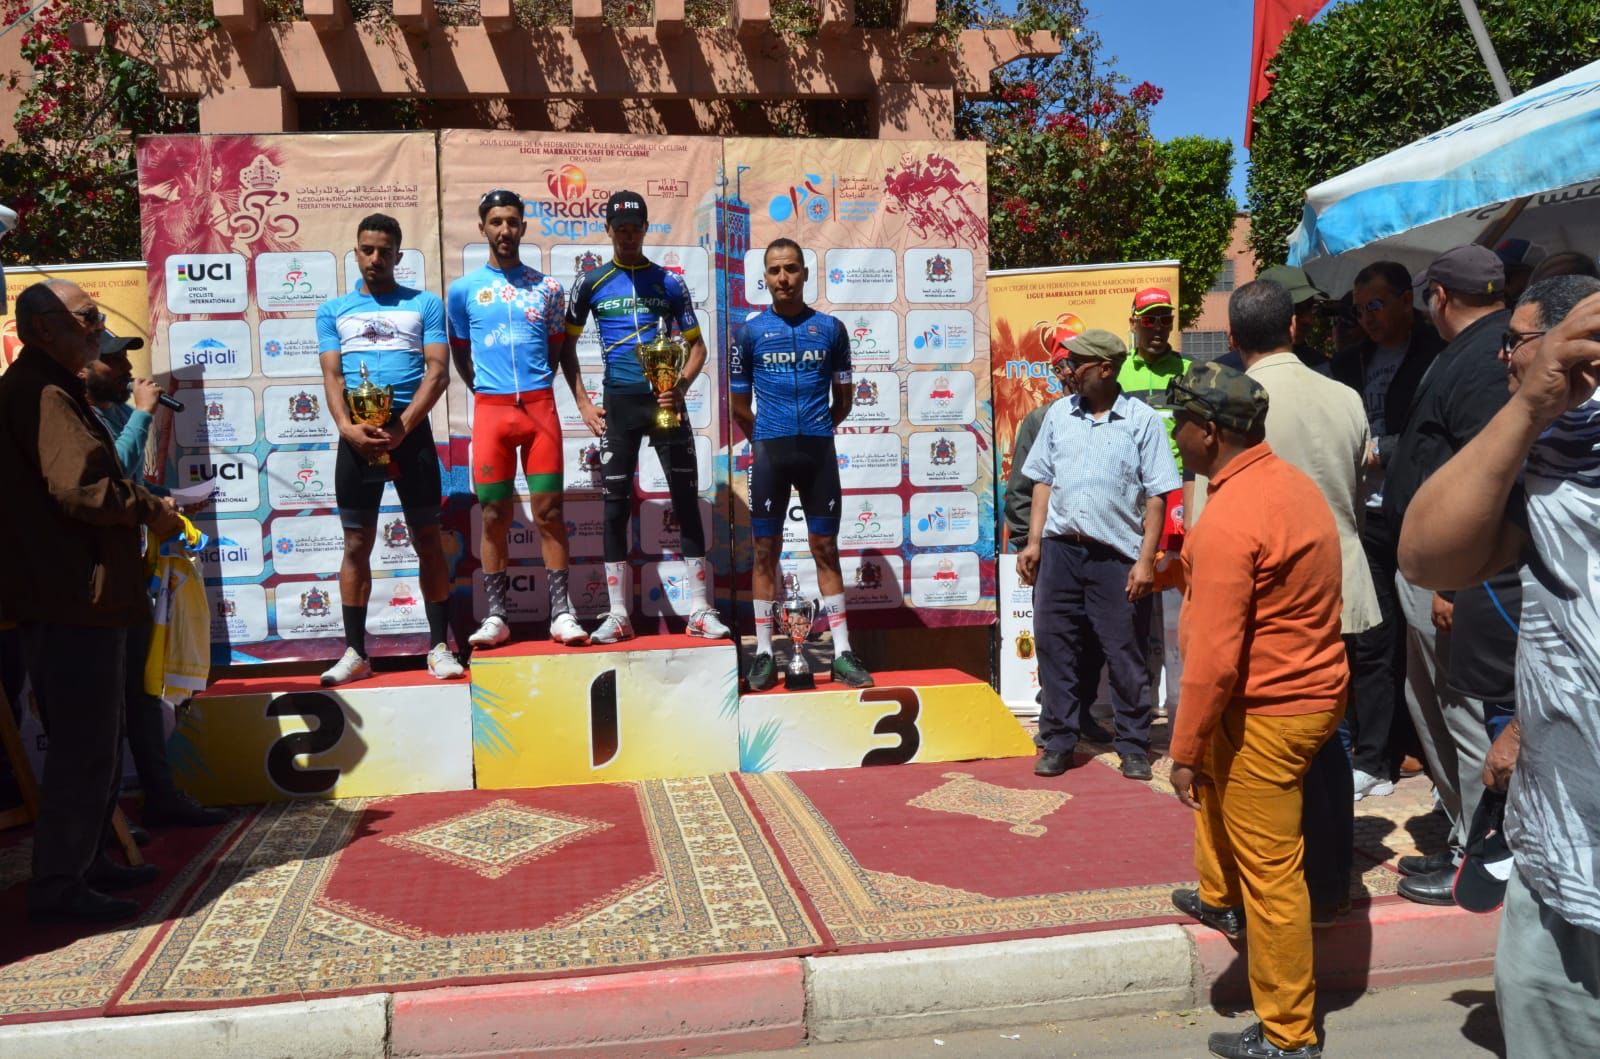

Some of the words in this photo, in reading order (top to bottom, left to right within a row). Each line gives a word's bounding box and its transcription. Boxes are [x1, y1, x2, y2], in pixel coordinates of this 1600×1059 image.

[188, 263, 231, 281] UCI
[597, 299, 620, 310] FES
[184, 349, 213, 365] sidi
[215, 349, 236, 364] ali
[762, 352, 796, 364] SIDI
[802, 350, 826, 362] ALI
[200, 463, 244, 480] UCI
[228, 548, 248, 562] ali
[591, 670, 618, 767] 1
[859, 688, 921, 766] 3
[266, 692, 344, 793] 2
